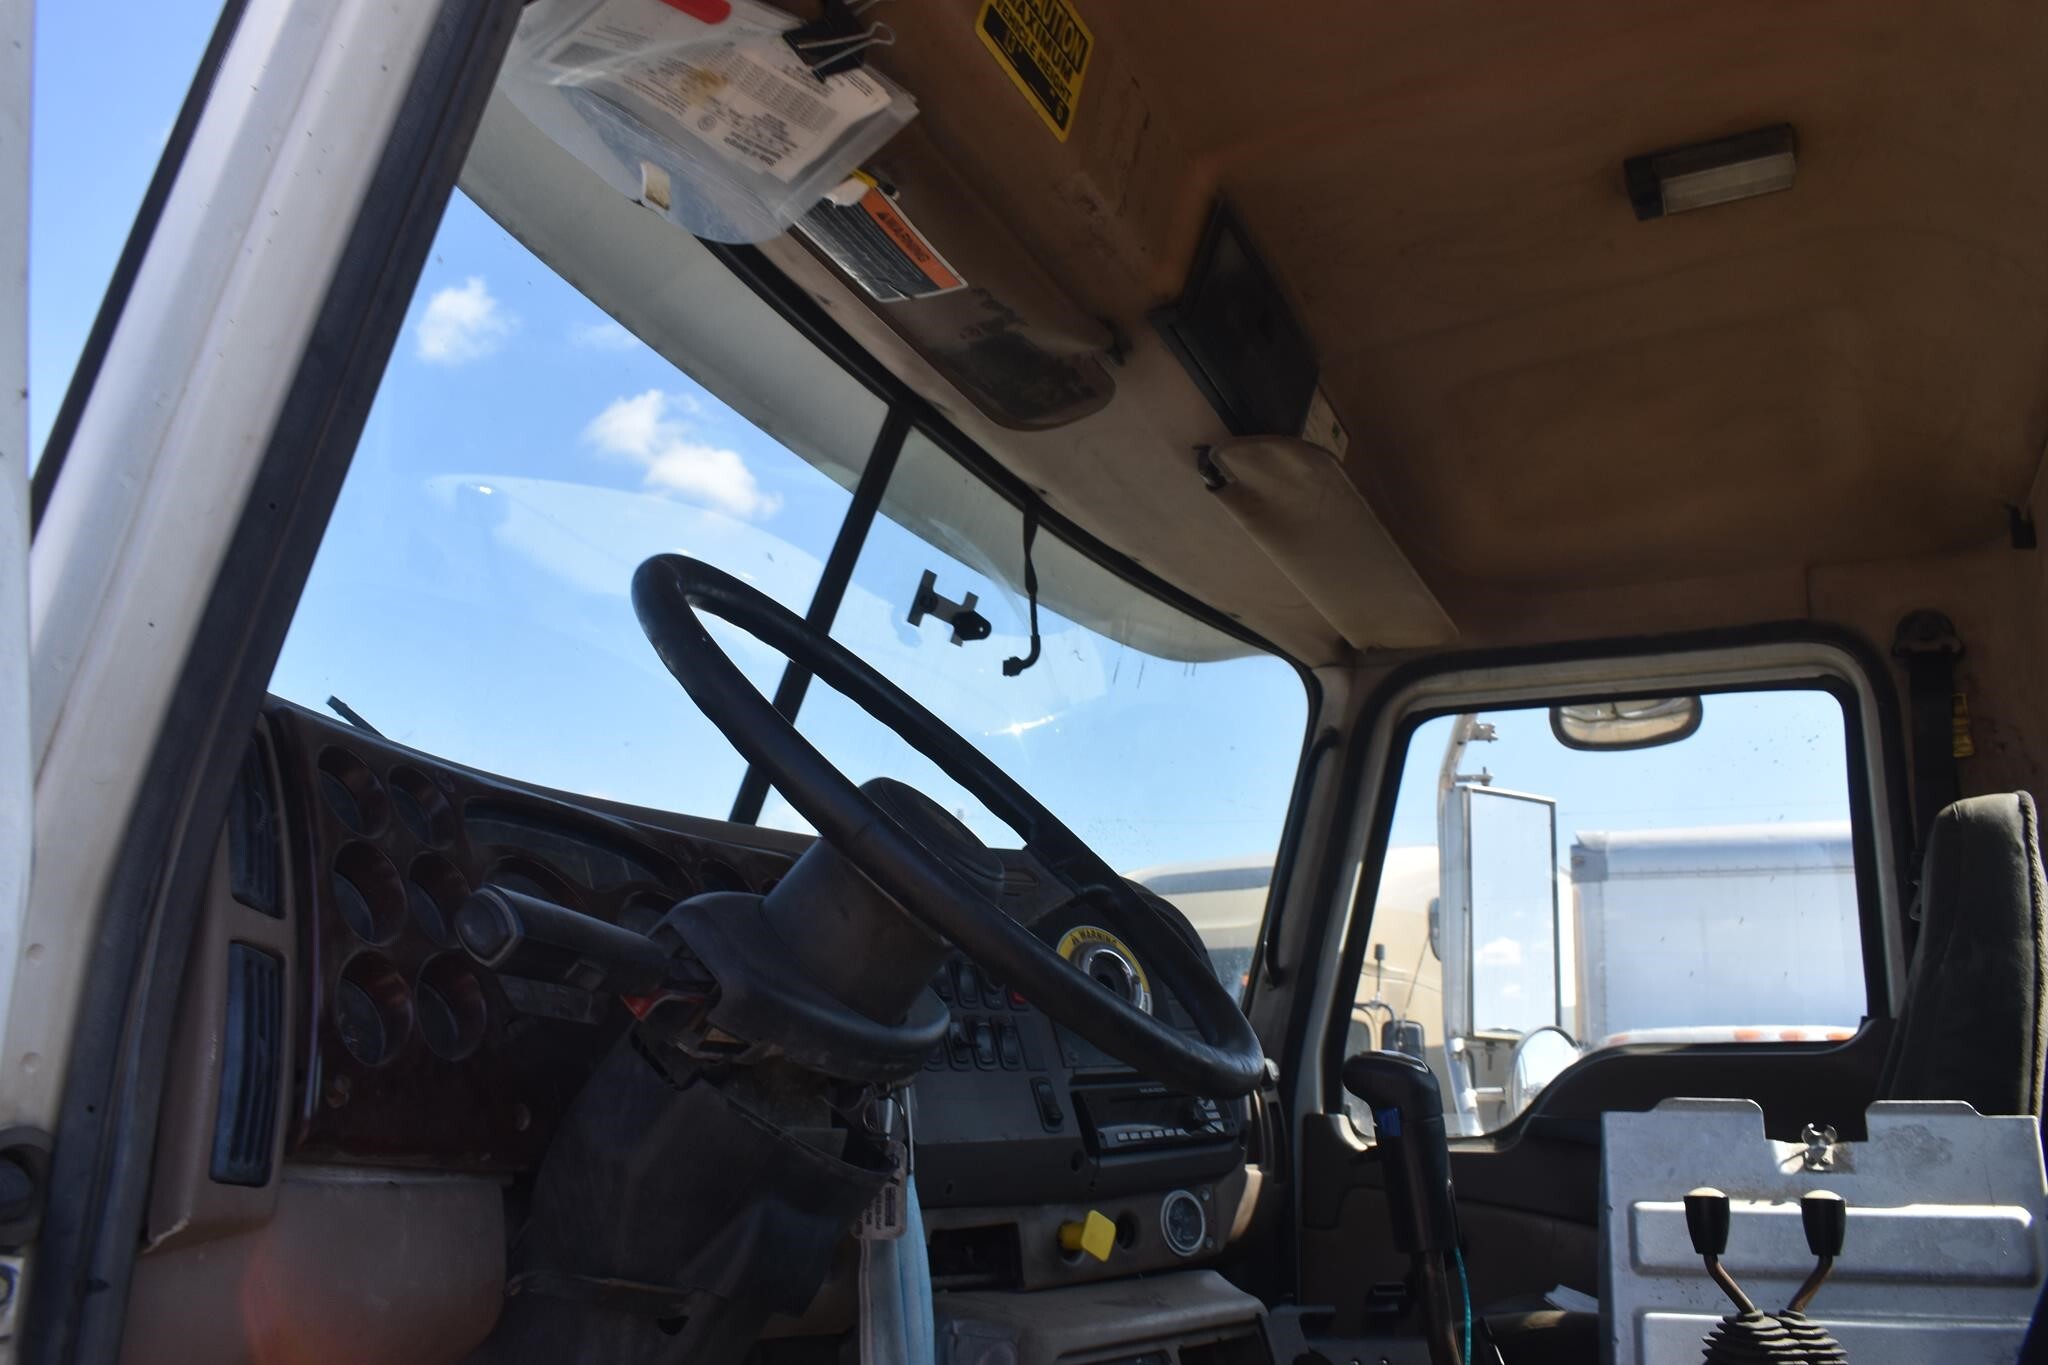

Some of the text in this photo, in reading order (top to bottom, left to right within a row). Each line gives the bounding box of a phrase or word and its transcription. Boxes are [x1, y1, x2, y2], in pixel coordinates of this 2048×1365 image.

[1029, 0, 1086, 69] AUTION
[1037, 53, 1072, 103] HEIGHT
[885, 218, 931, 264] WARNING
[1079, 928, 1119, 945] WARNING
